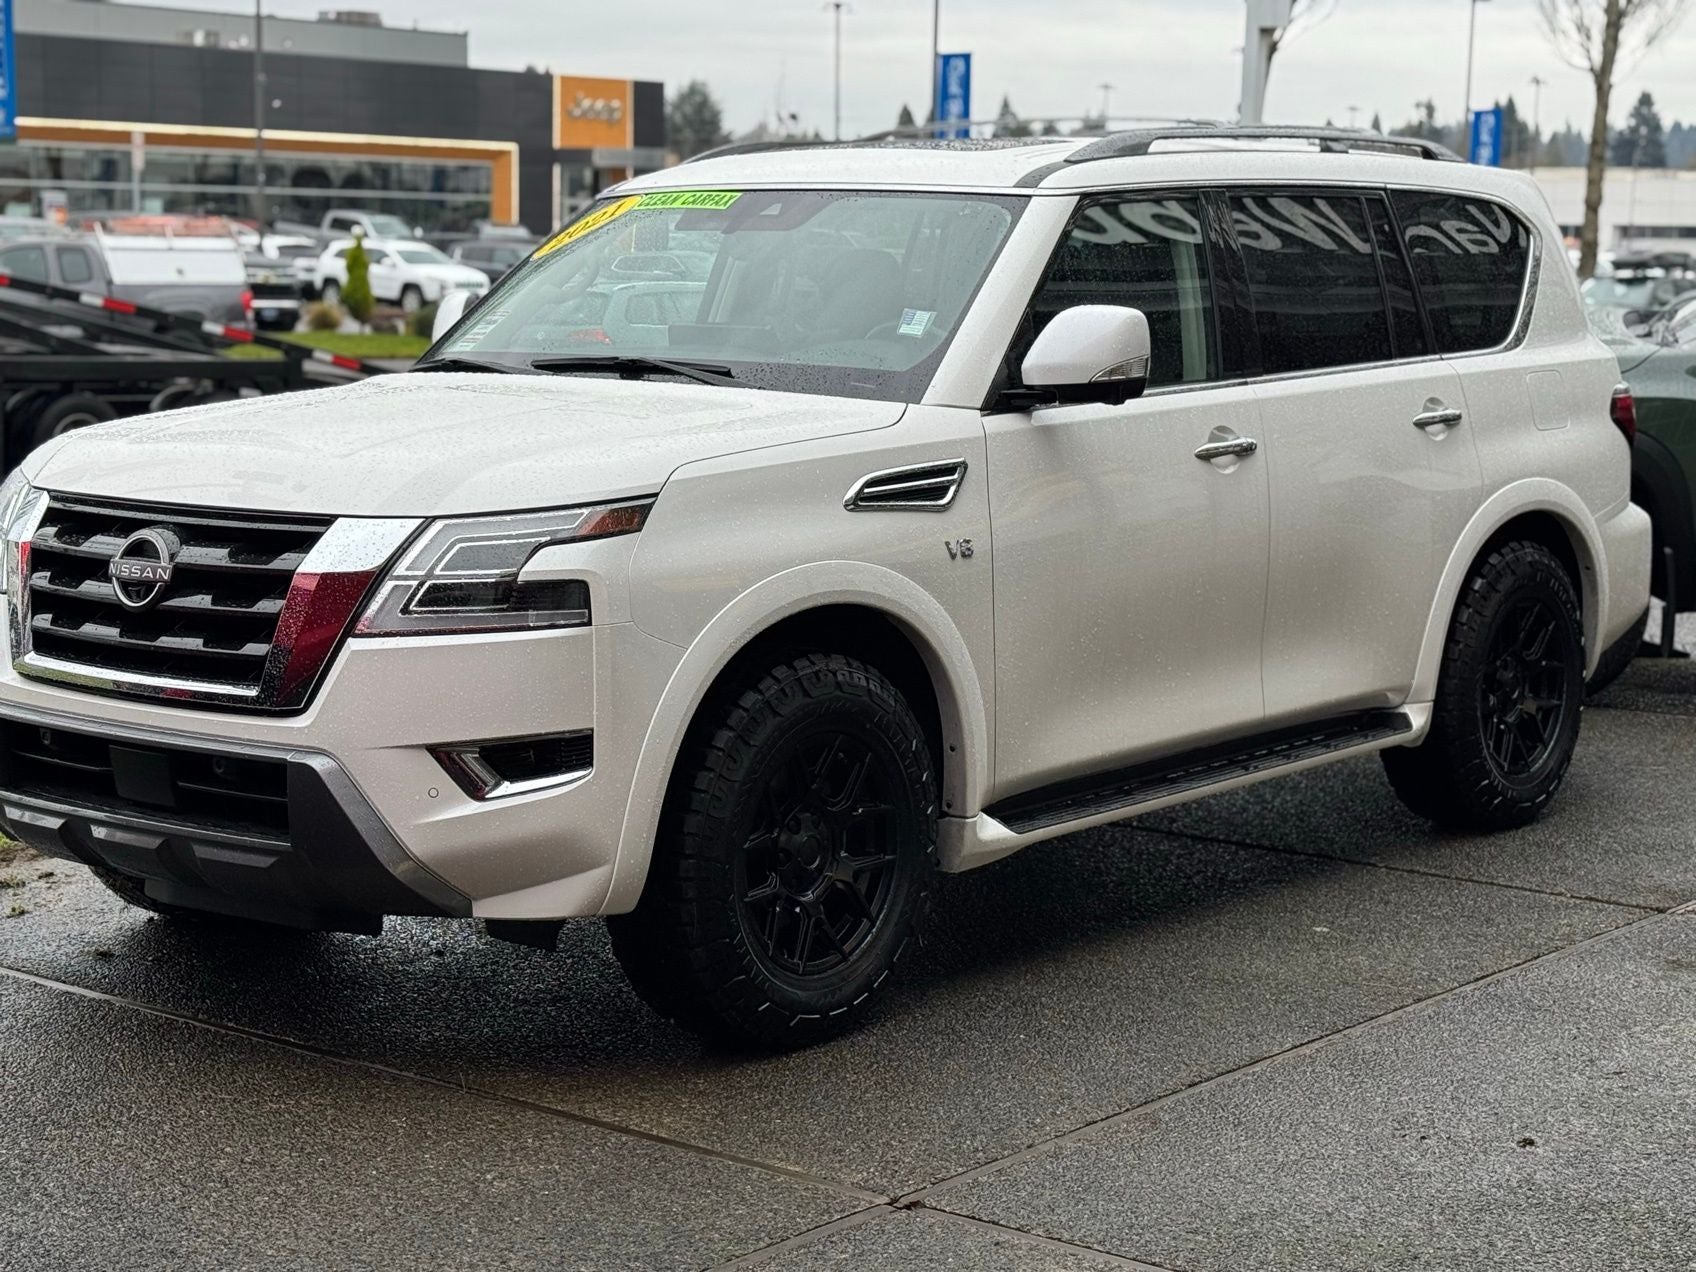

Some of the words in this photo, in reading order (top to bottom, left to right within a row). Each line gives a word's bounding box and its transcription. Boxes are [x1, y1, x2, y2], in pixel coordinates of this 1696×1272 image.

[567, 90, 623, 127] Jeep
[637, 194, 685, 207] CLEAN
[681, 193, 738, 207] CARFAX
[548, 201, 627, 251] 2021
[109, 562, 170, 580] NISSAN
